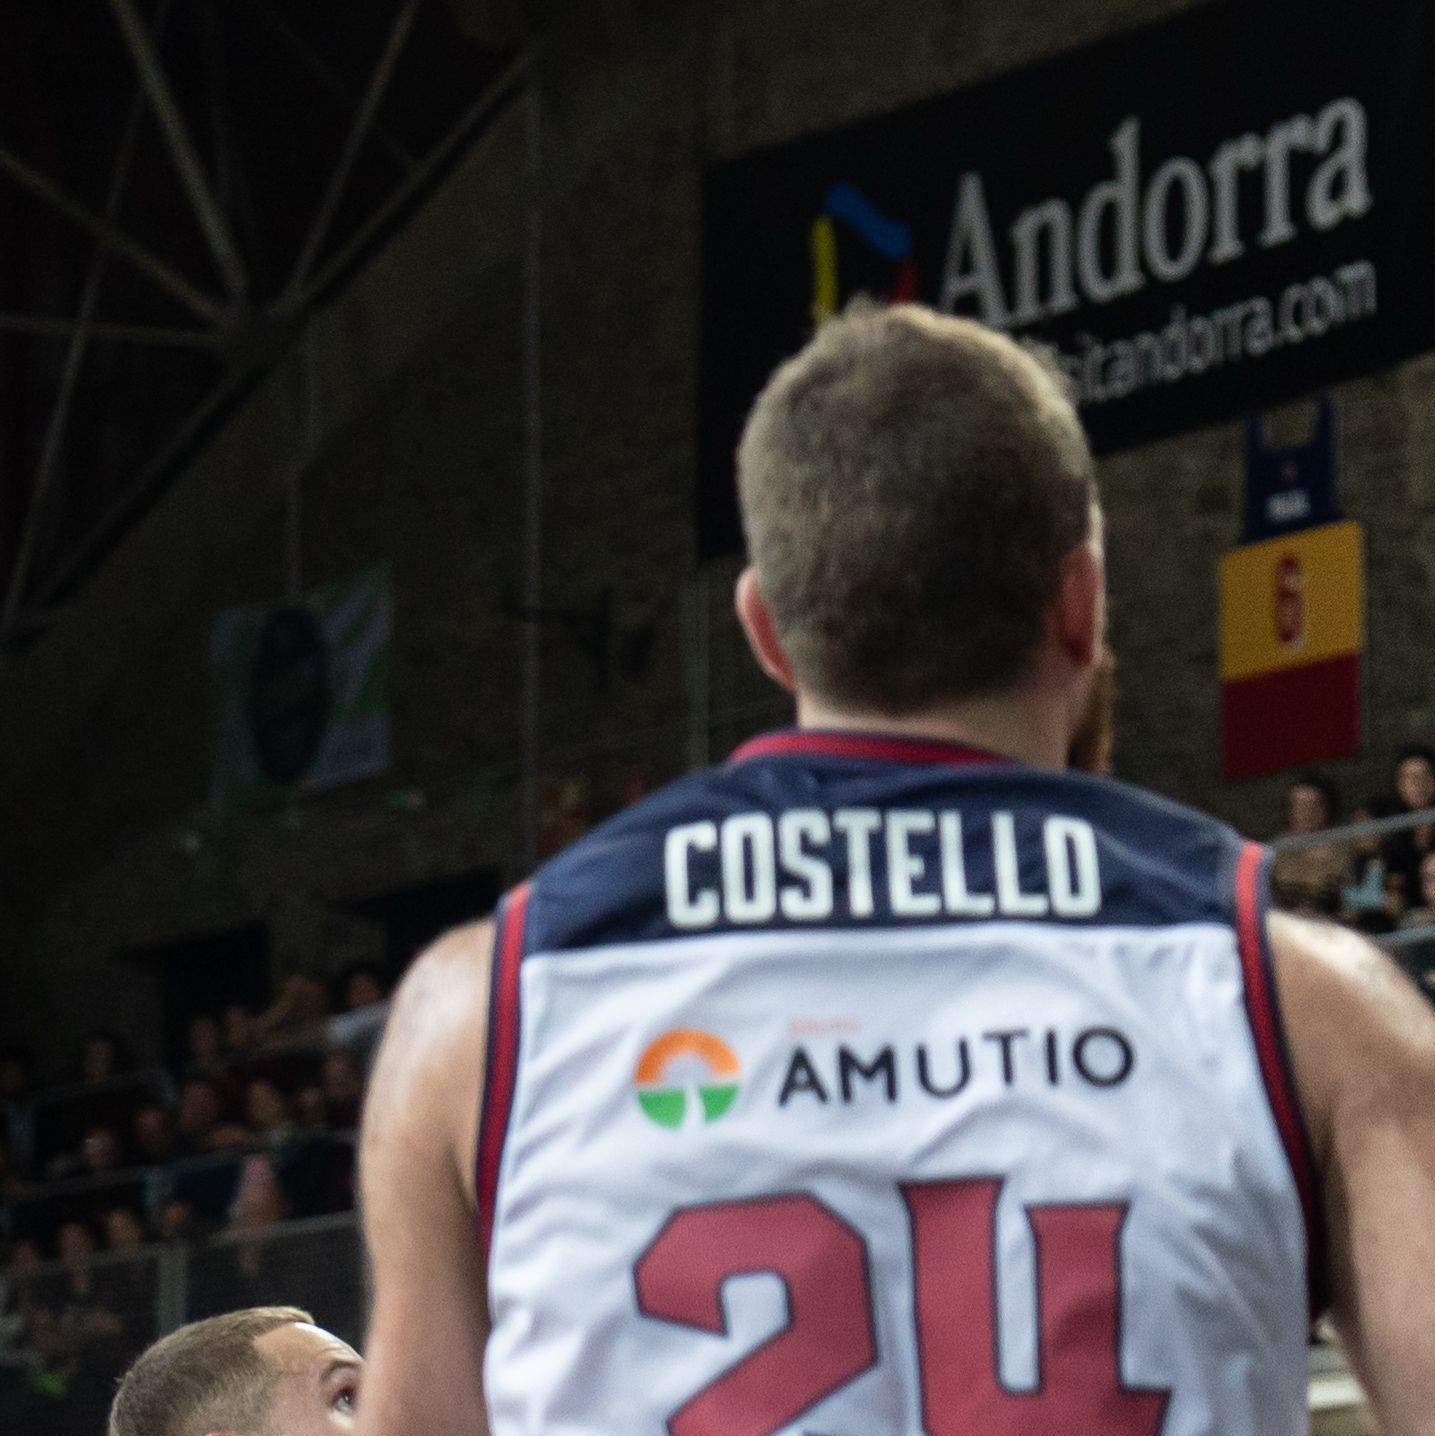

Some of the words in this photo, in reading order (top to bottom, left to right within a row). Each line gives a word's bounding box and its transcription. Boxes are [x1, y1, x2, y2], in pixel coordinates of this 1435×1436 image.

[940, 96, 1374, 332] Andorra
[663, 808, 1102, 928] COSTELLO
[777, 1025, 1136, 1109] AMUTIO
